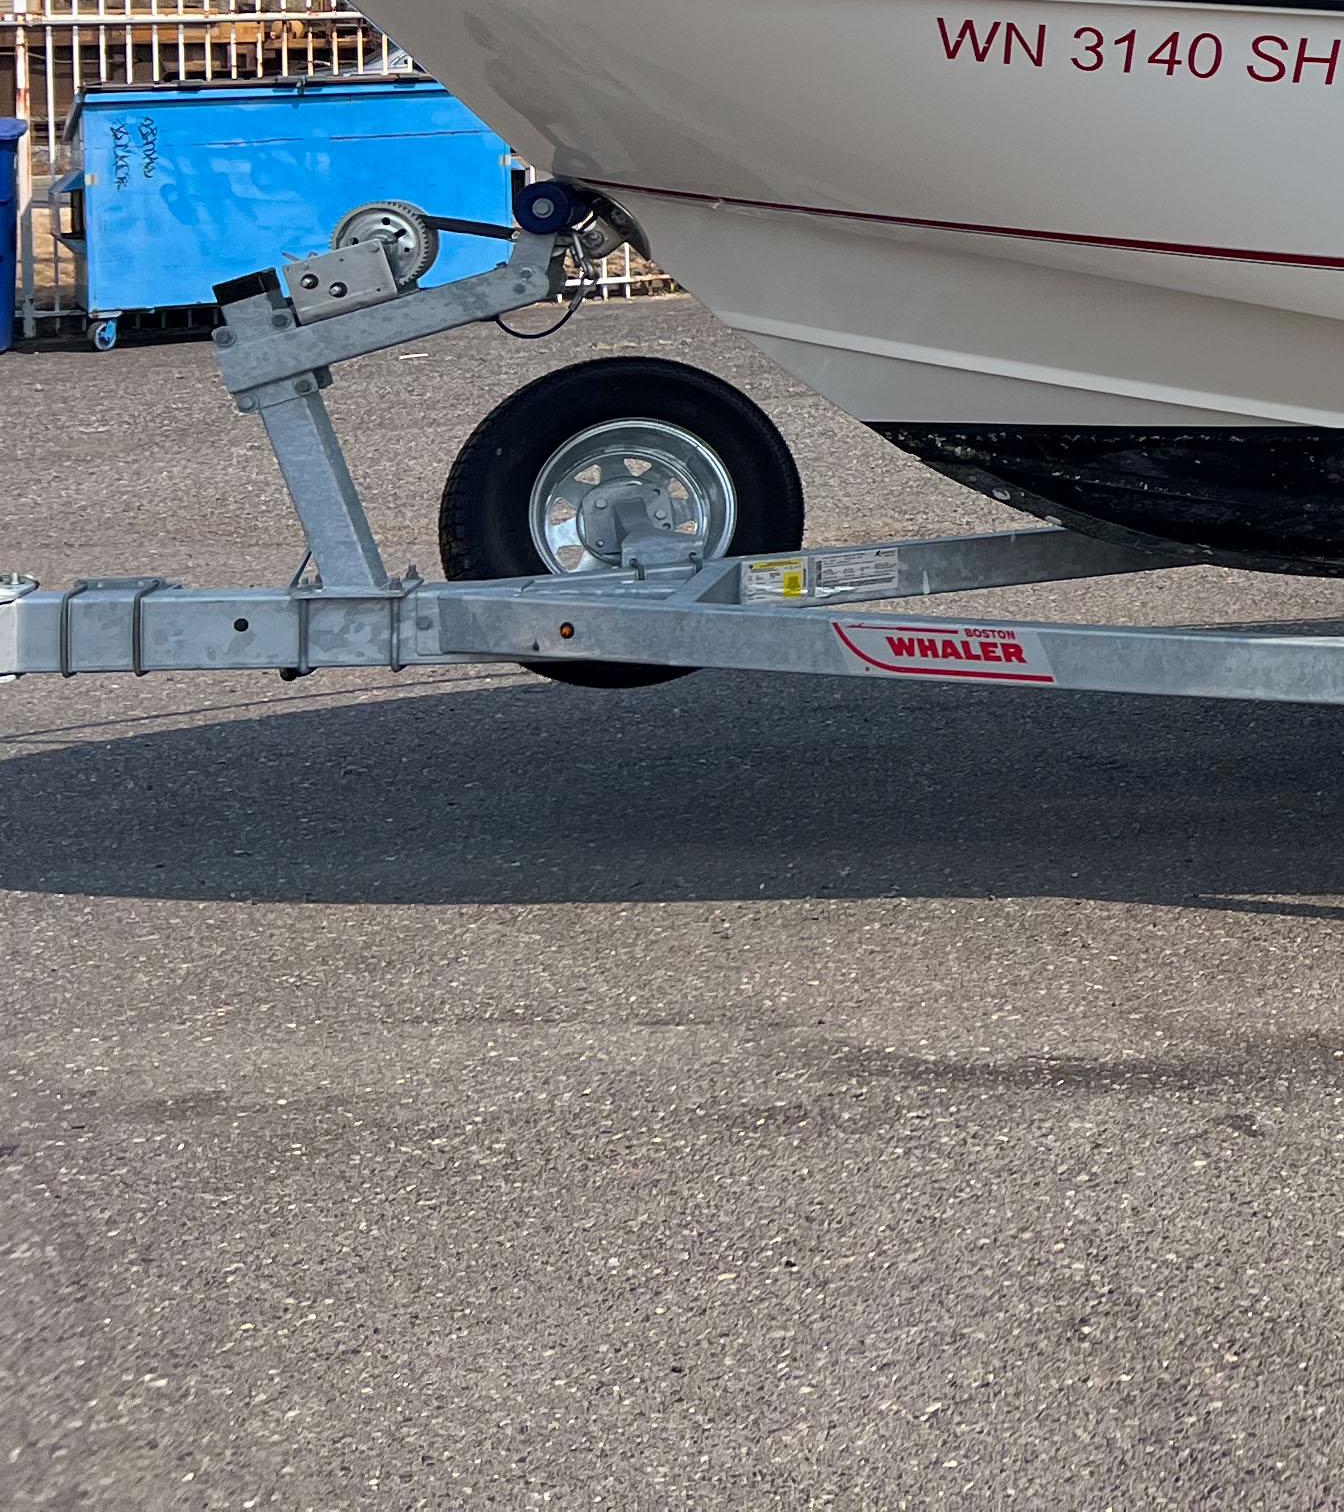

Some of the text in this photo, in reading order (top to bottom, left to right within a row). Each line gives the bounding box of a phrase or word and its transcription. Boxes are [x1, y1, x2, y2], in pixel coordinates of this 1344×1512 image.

[937, 17, 1342, 86] WN 3140 SH
[963, 628, 1016, 640] BOSTON
[885, 636, 1028, 664] WHALER
